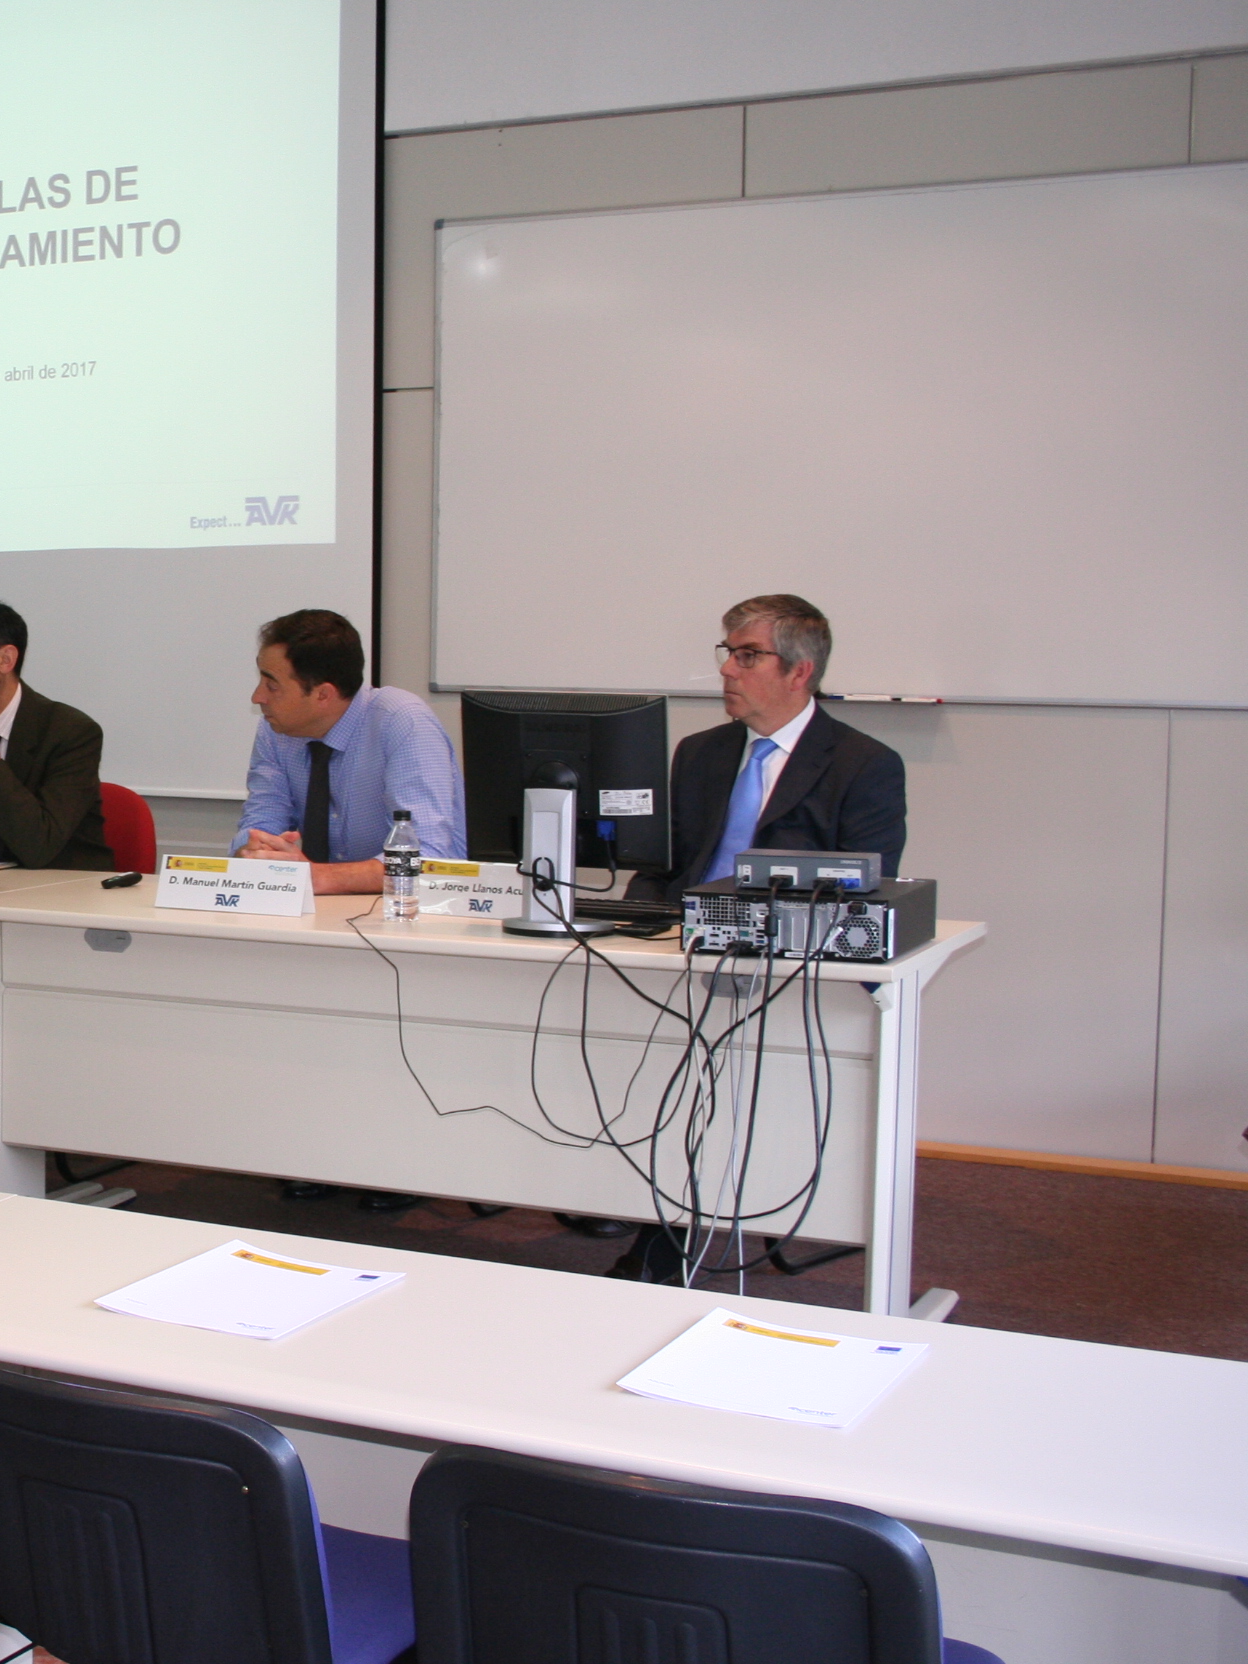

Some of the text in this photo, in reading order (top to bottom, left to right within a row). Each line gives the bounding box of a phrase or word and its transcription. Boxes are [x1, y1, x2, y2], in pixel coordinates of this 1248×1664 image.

[85, 165, 139, 205] DE
[4, 366, 34, 382] abril
[39, 365, 56, 380] de
[61, 361, 97, 378] 2017
[245, 495, 299, 526] AVK
[169, 876, 297, 893] D. Manuel Martín Guardia
[429, 881, 523, 896] D. Jorge Llanos Acu
[214, 893, 240, 907] AVK
[468, 899, 493, 913] AVK
